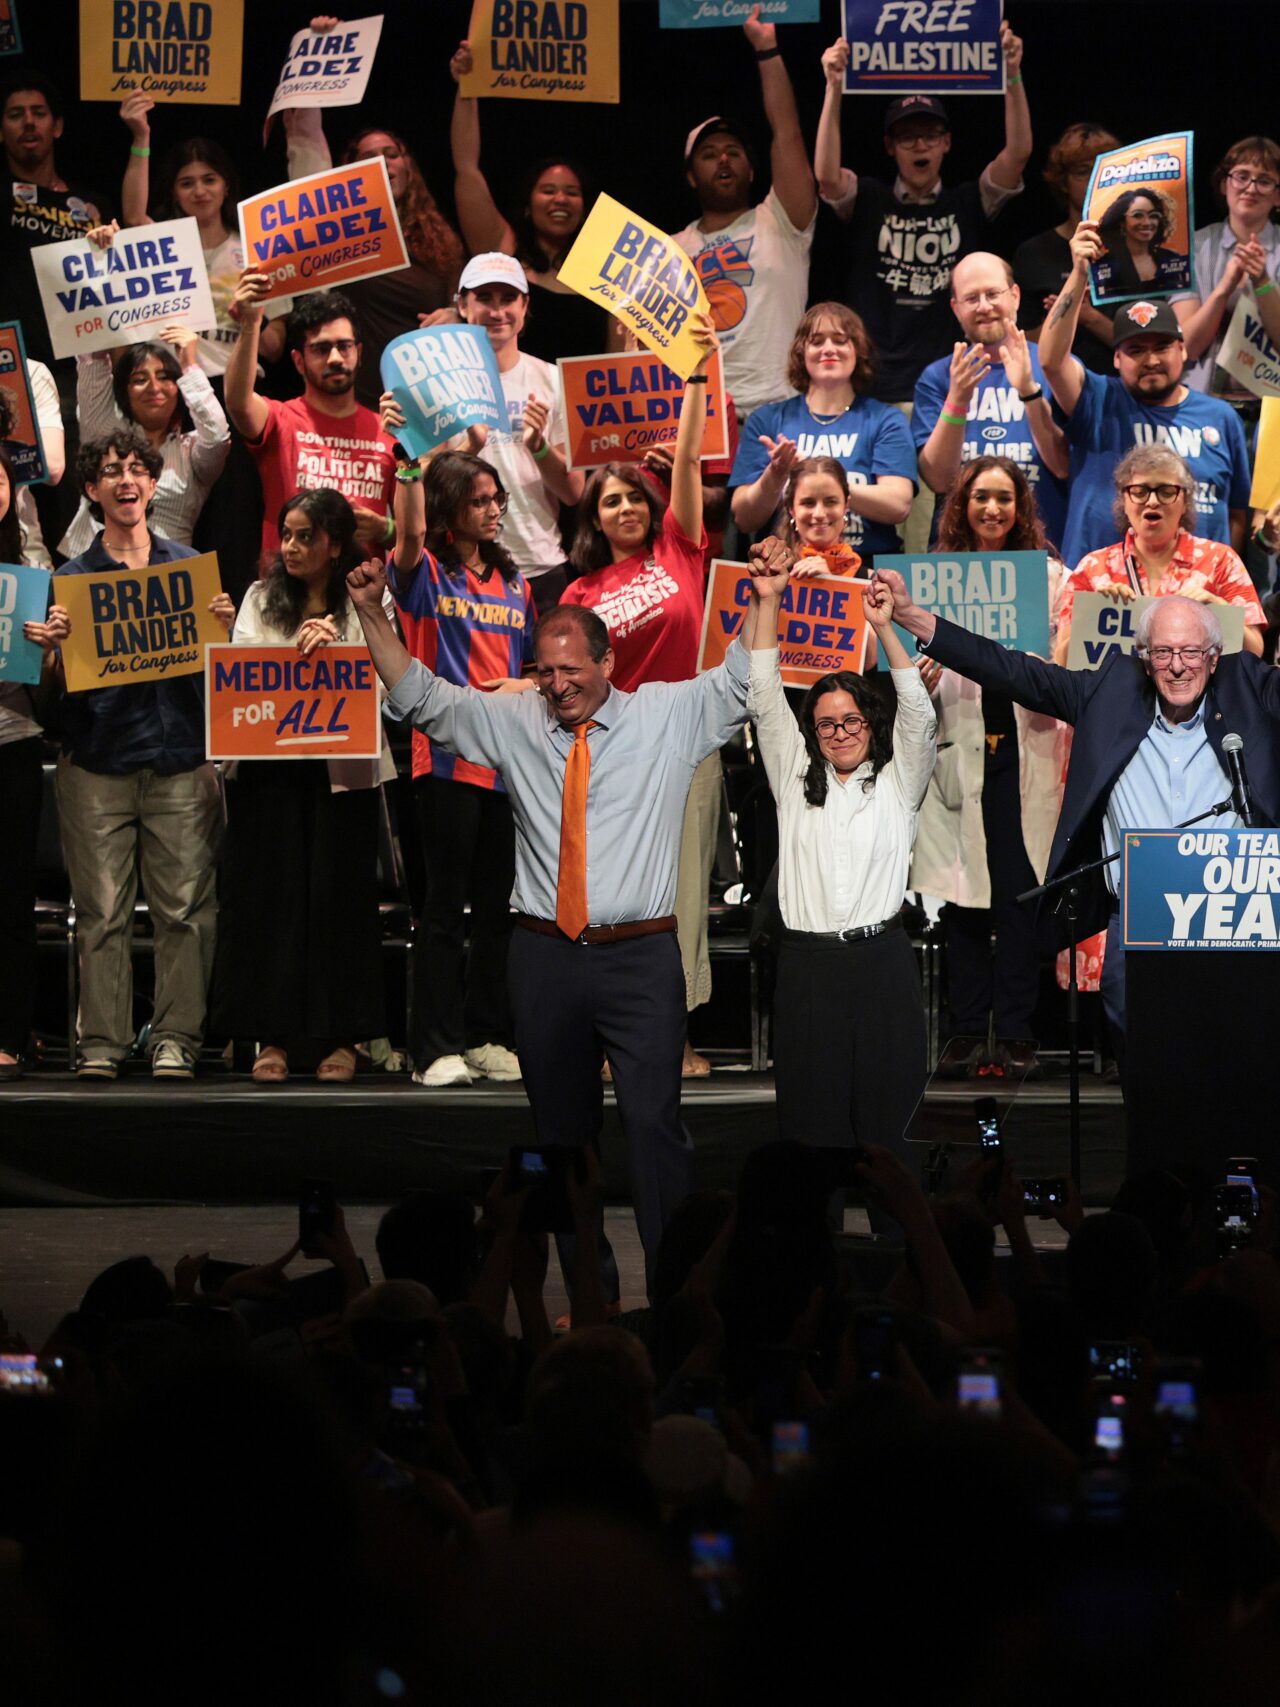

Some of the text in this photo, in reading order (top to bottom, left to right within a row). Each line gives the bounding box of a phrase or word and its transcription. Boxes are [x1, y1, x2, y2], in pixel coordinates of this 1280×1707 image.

[113, 0, 212, 41] BRAD
[492, 0, 587, 41] BRAD
[693, 1, 720, 20] for
[875, 0, 976, 37] FREE
[112, 41, 210, 76] LANDER
[282, 56, 363, 82] LDEZ
[491, 39, 587, 75] LANDER
[852, 41, 997, 72] PALESTINE
[111, 76, 207, 96] for Congress
[490, 73, 585, 94] for Congress
[260, 177, 367, 231] CLAIRE
[253, 207, 387, 260] VALDEZ
[878, 223, 961, 264] NIOU
[62, 236, 178, 283] CLAIRE
[267, 237, 381, 285] FOR CONGRESS
[613, 221, 698, 308] BRAD
[56, 267, 197, 313] VALDEZ
[590, 284, 617, 301] for
[599, 253, 688, 338] LANDER
[75, 296, 191, 337] FOR CONGRESS
[391, 331, 484, 387] BRAD
[408, 368, 496, 418] LANDER
[585, 363, 685, 398] CLAIR
[296, 431, 386, 452] CONTINUING
[433, 412, 456, 436] for
[591, 427, 678, 453] FOR CONGR
[330, 449, 351, 459] the
[797, 432, 858, 458] UAW
[297, 451, 384, 482] POLITICAL
[90, 570, 193, 624] BRAD
[735, 578, 849, 620] CAIRE
[911, 560, 1016, 605] BRAD
[435, 594, 470, 619] NEW
[467, 600, 511, 627] YORK
[616, 606, 664, 638] of America
[94, 611, 197, 659] LANDER
[99, 649, 198, 678] for Congress
[215, 658, 371, 693] MEDICARE
[233, 697, 350, 735] FOR ALL
[1178, 834, 1229, 856] OUR
[1196, 940, 1210, 948] THE
[1211, 940, 1256, 948] DEMOCRATIC
